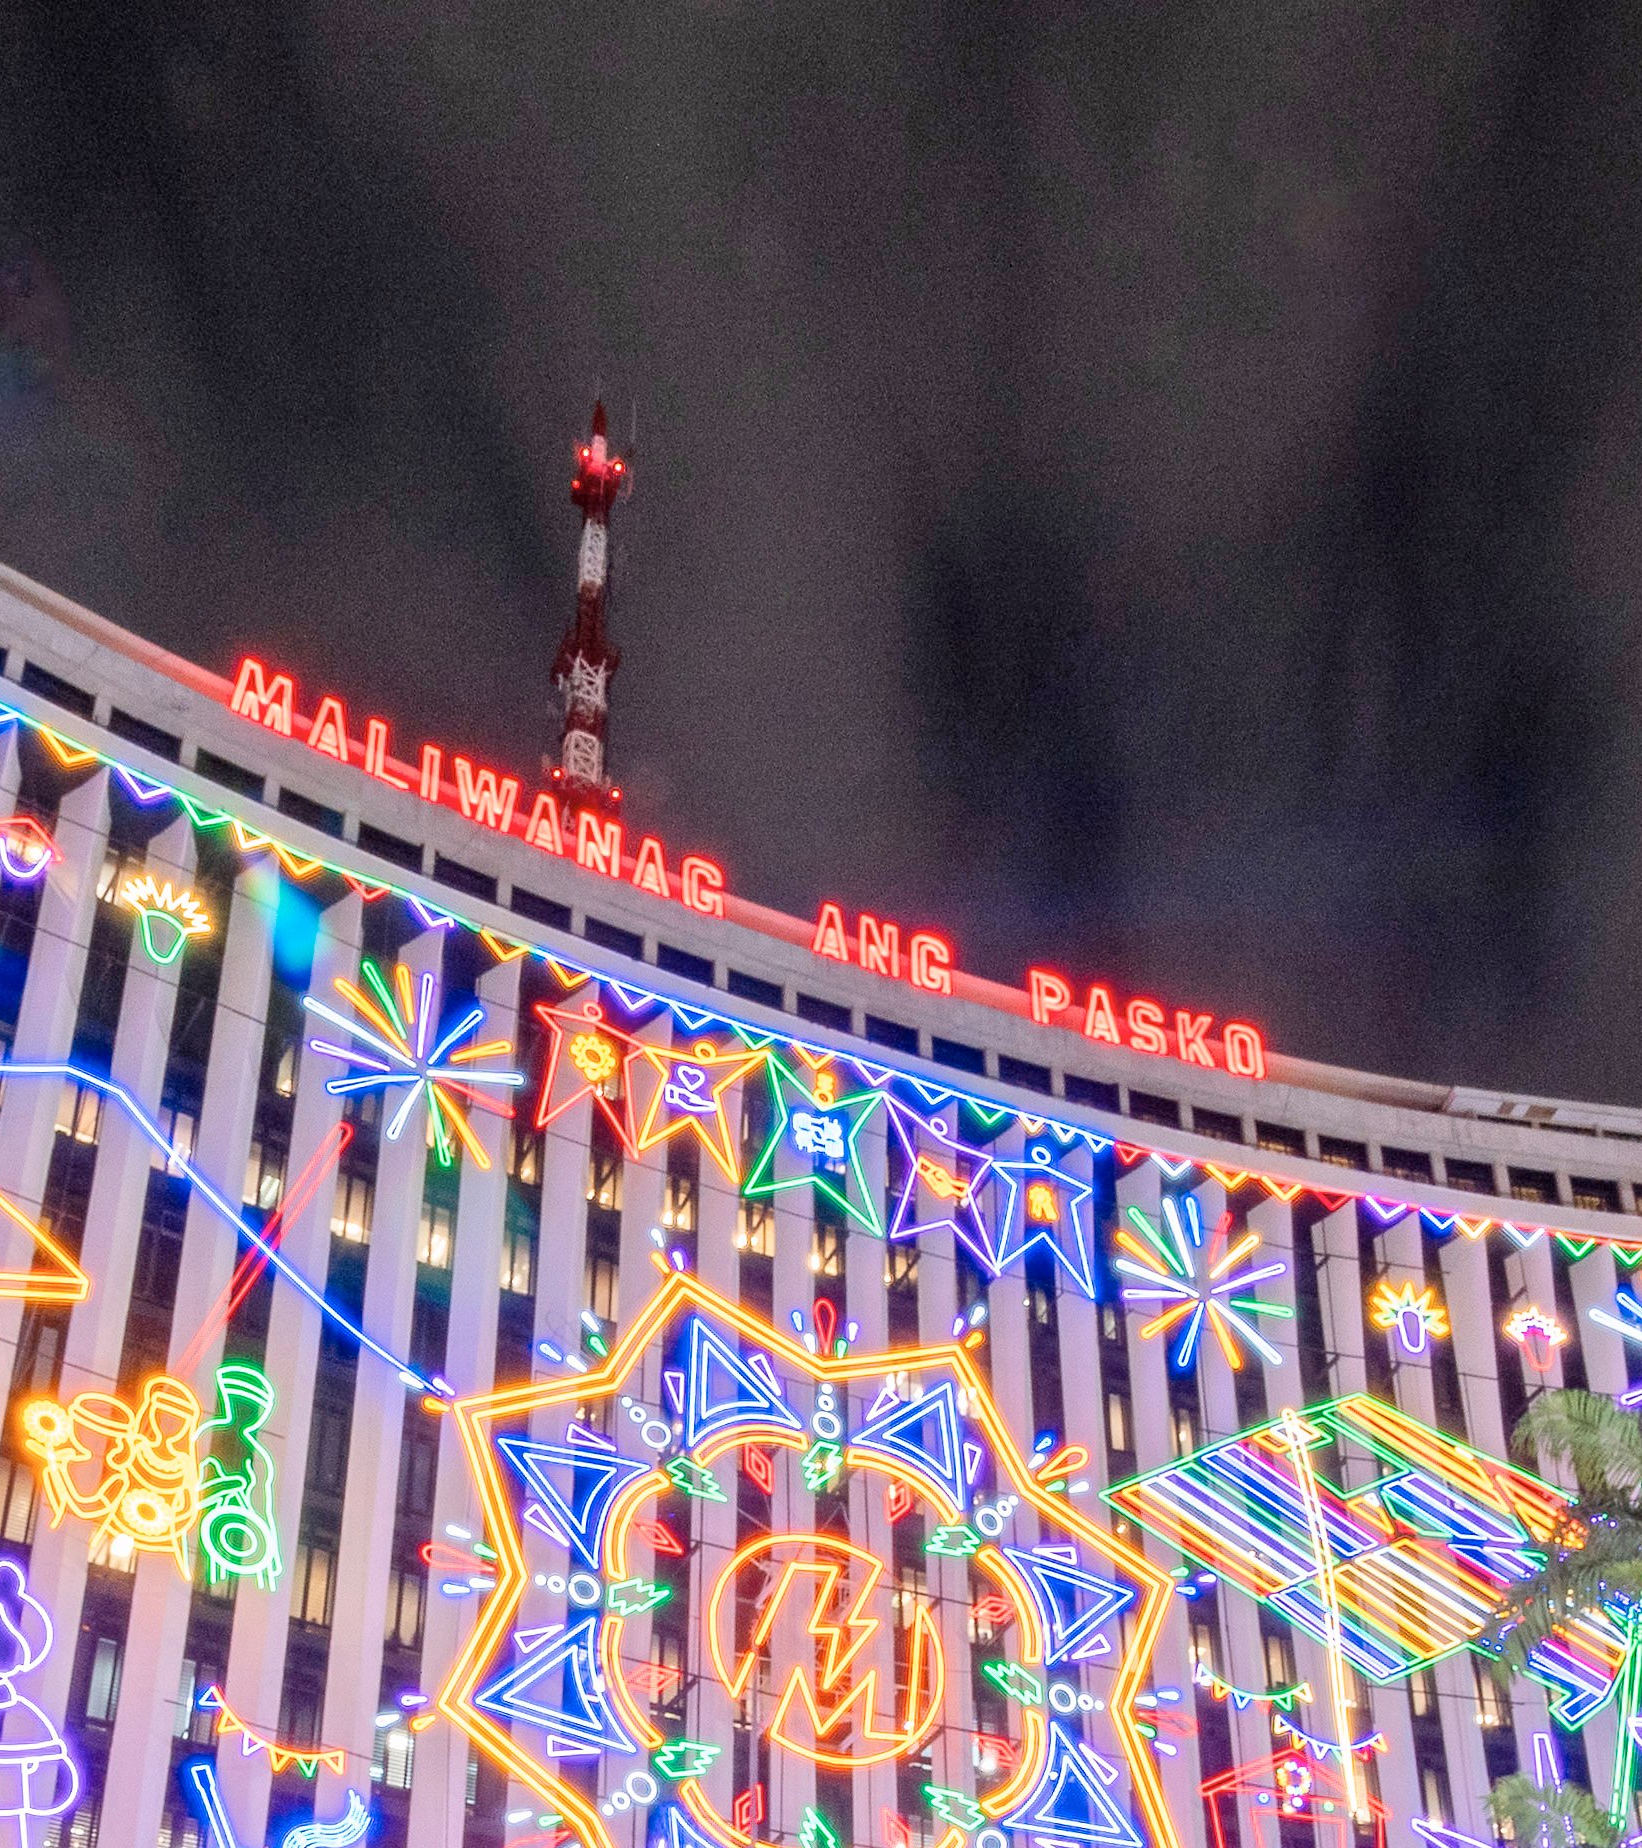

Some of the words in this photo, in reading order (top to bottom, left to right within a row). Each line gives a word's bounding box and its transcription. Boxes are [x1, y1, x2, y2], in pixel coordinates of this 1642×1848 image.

[229, 656, 726, 920] MALIWANAG
[812, 901, 952, 996] ANG
[1027, 968, 1267, 1080] PASKO
